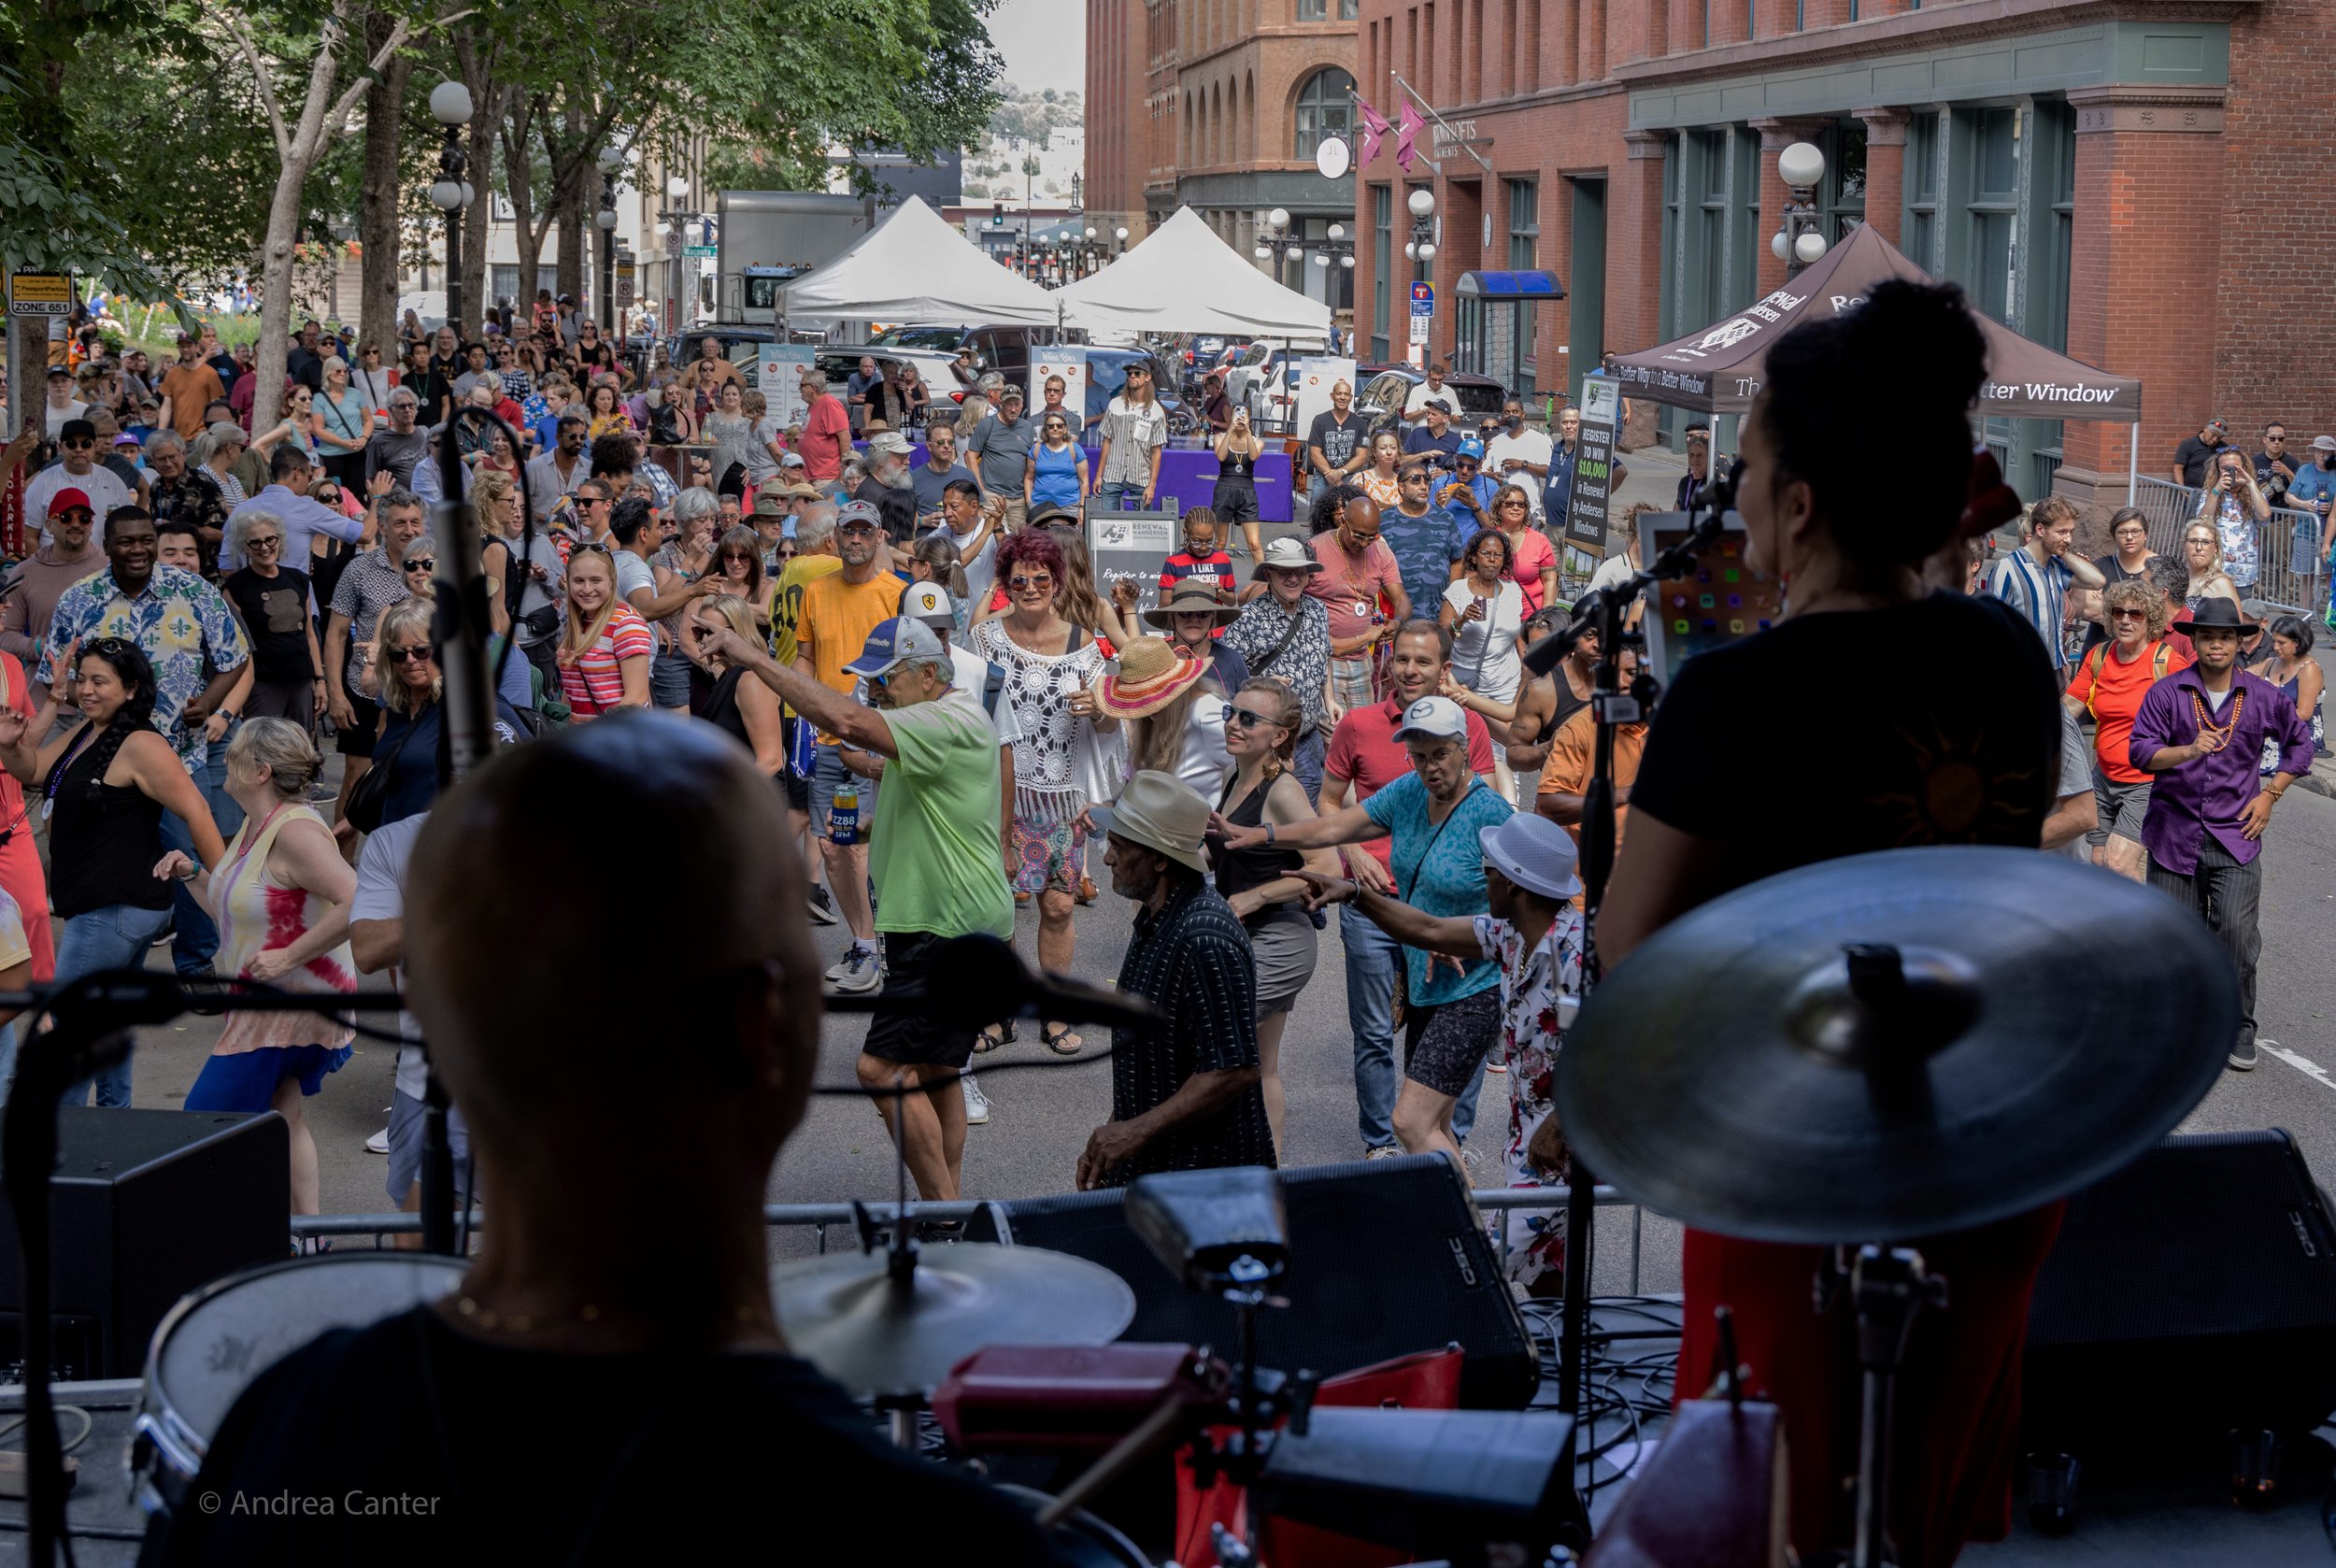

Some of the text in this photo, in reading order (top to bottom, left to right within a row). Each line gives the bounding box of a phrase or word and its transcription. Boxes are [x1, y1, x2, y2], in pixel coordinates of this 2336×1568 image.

[1451, 120, 1476, 141] LOFTS
[683, 247, 711, 257] Wacouta
[15, 303, 67, 311] ZONE 651
[1619, 365, 1637, 381] Better
[1637, 367, 1650, 389] Way
[1661, 370, 1679, 390] Better
[1679, 374, 1705, 394] Window
[1736, 377, 1760, 396] Th
[1582, 428, 1610, 445] REGISTER
[1584, 445, 1604, 461] TO WIN
[1578, 459, 1607, 479] $10,000
[1576, 480, 1605, 499] in Renewal
[1573, 499, 1604, 519] by Andersen
[1574, 519, 1599, 537] Windows
[1103, 568, 1136, 582] Register
[1139, 571, 1147, 579] to
[1191, 563, 1215, 573] I LIKE
[1147, 588, 1154, 597] in
